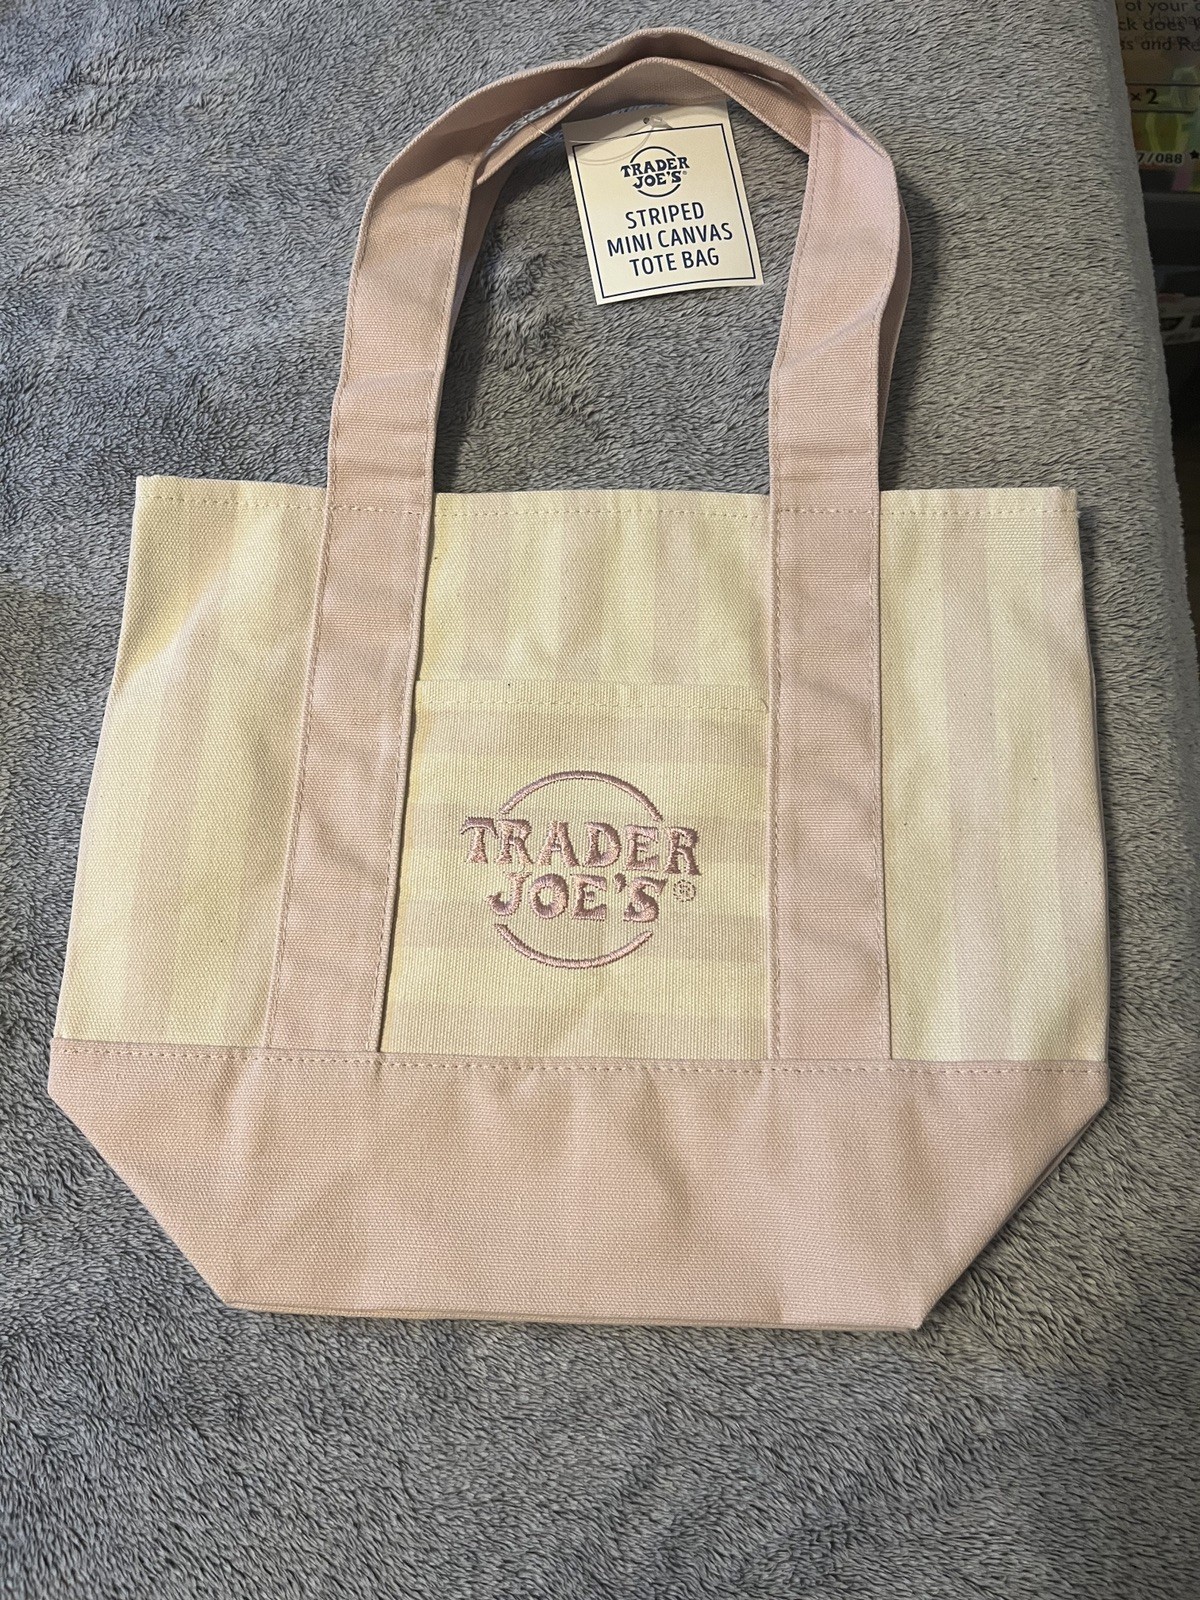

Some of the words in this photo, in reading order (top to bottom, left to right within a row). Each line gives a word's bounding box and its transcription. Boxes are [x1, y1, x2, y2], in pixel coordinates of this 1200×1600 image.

[1147, 2, 1188, 15] your
[1143, 18, 1185, 31] does
[1141, 37, 1171, 50] and
[620, 156, 690, 177] TRADER
[625, 201, 705, 229] STRIPED
[607, 233, 652, 257] MINI
[657, 223, 733, 248] CANVAS
[629, 253, 677, 276] TOTE
[682, 248, 720, 269] BAG
[461, 816, 702, 876] TRADER
